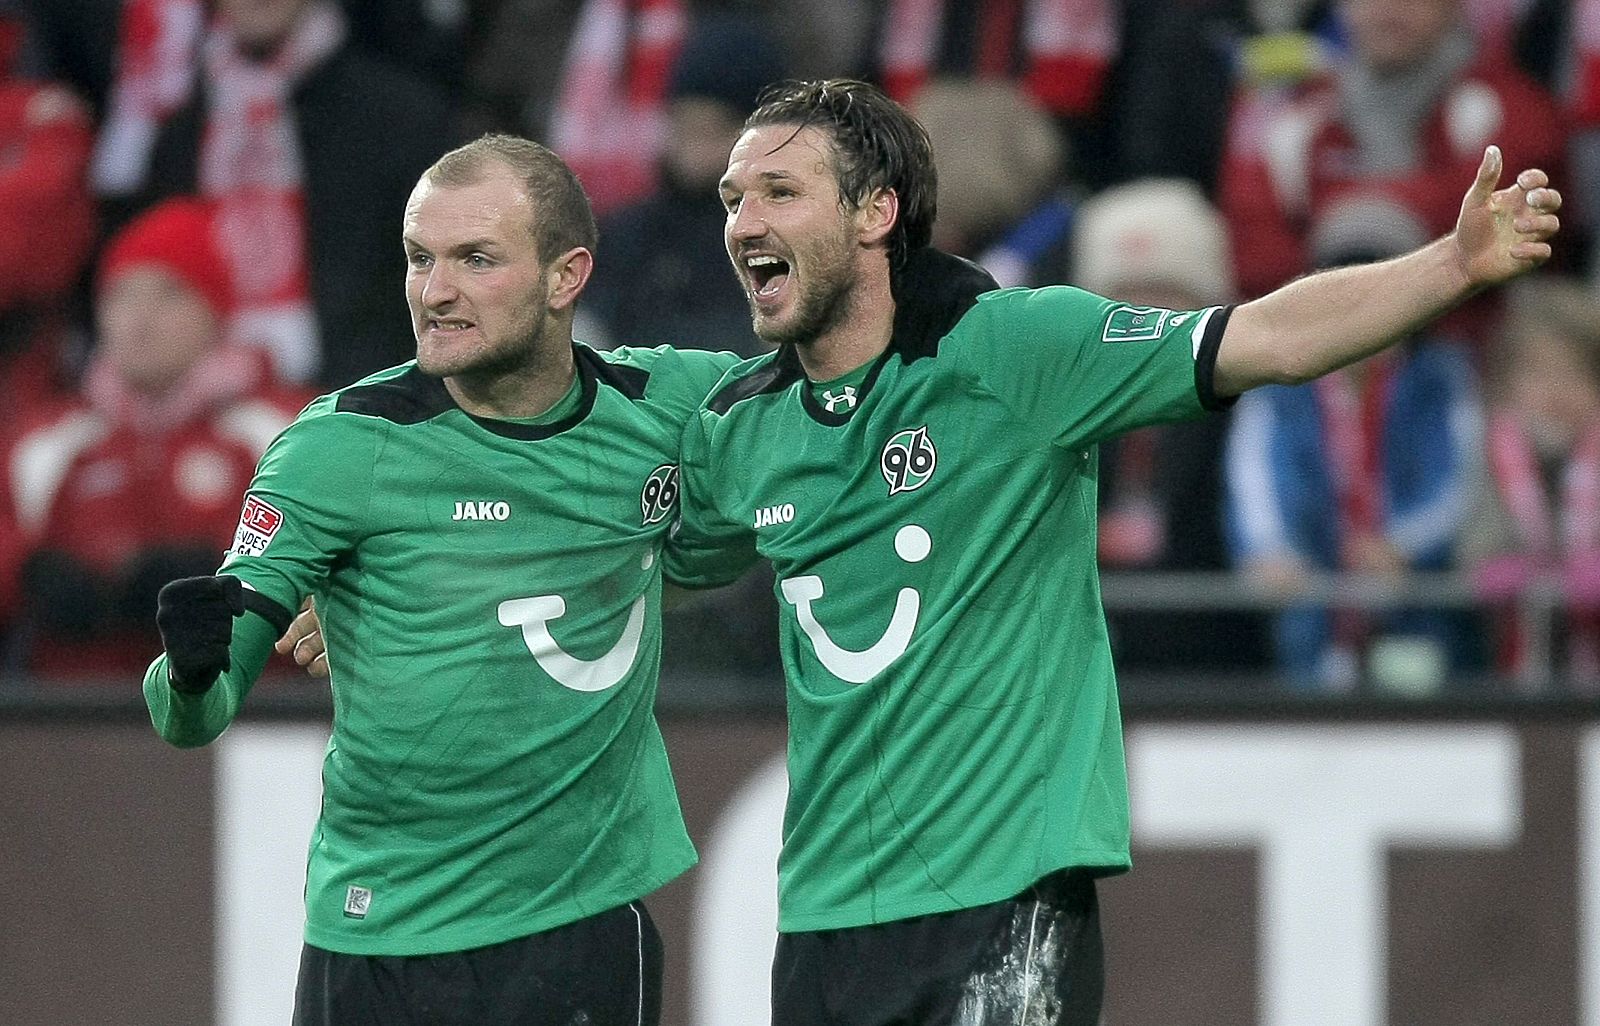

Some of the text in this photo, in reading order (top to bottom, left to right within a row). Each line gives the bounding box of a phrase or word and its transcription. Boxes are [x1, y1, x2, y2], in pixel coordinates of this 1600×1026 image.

[881, 426, 936, 495] 96
[642, 465, 679, 525] 96
[452, 501, 510, 520] JAKO
[754, 503, 795, 529] JAKO
[239, 529, 268, 551] NDES
